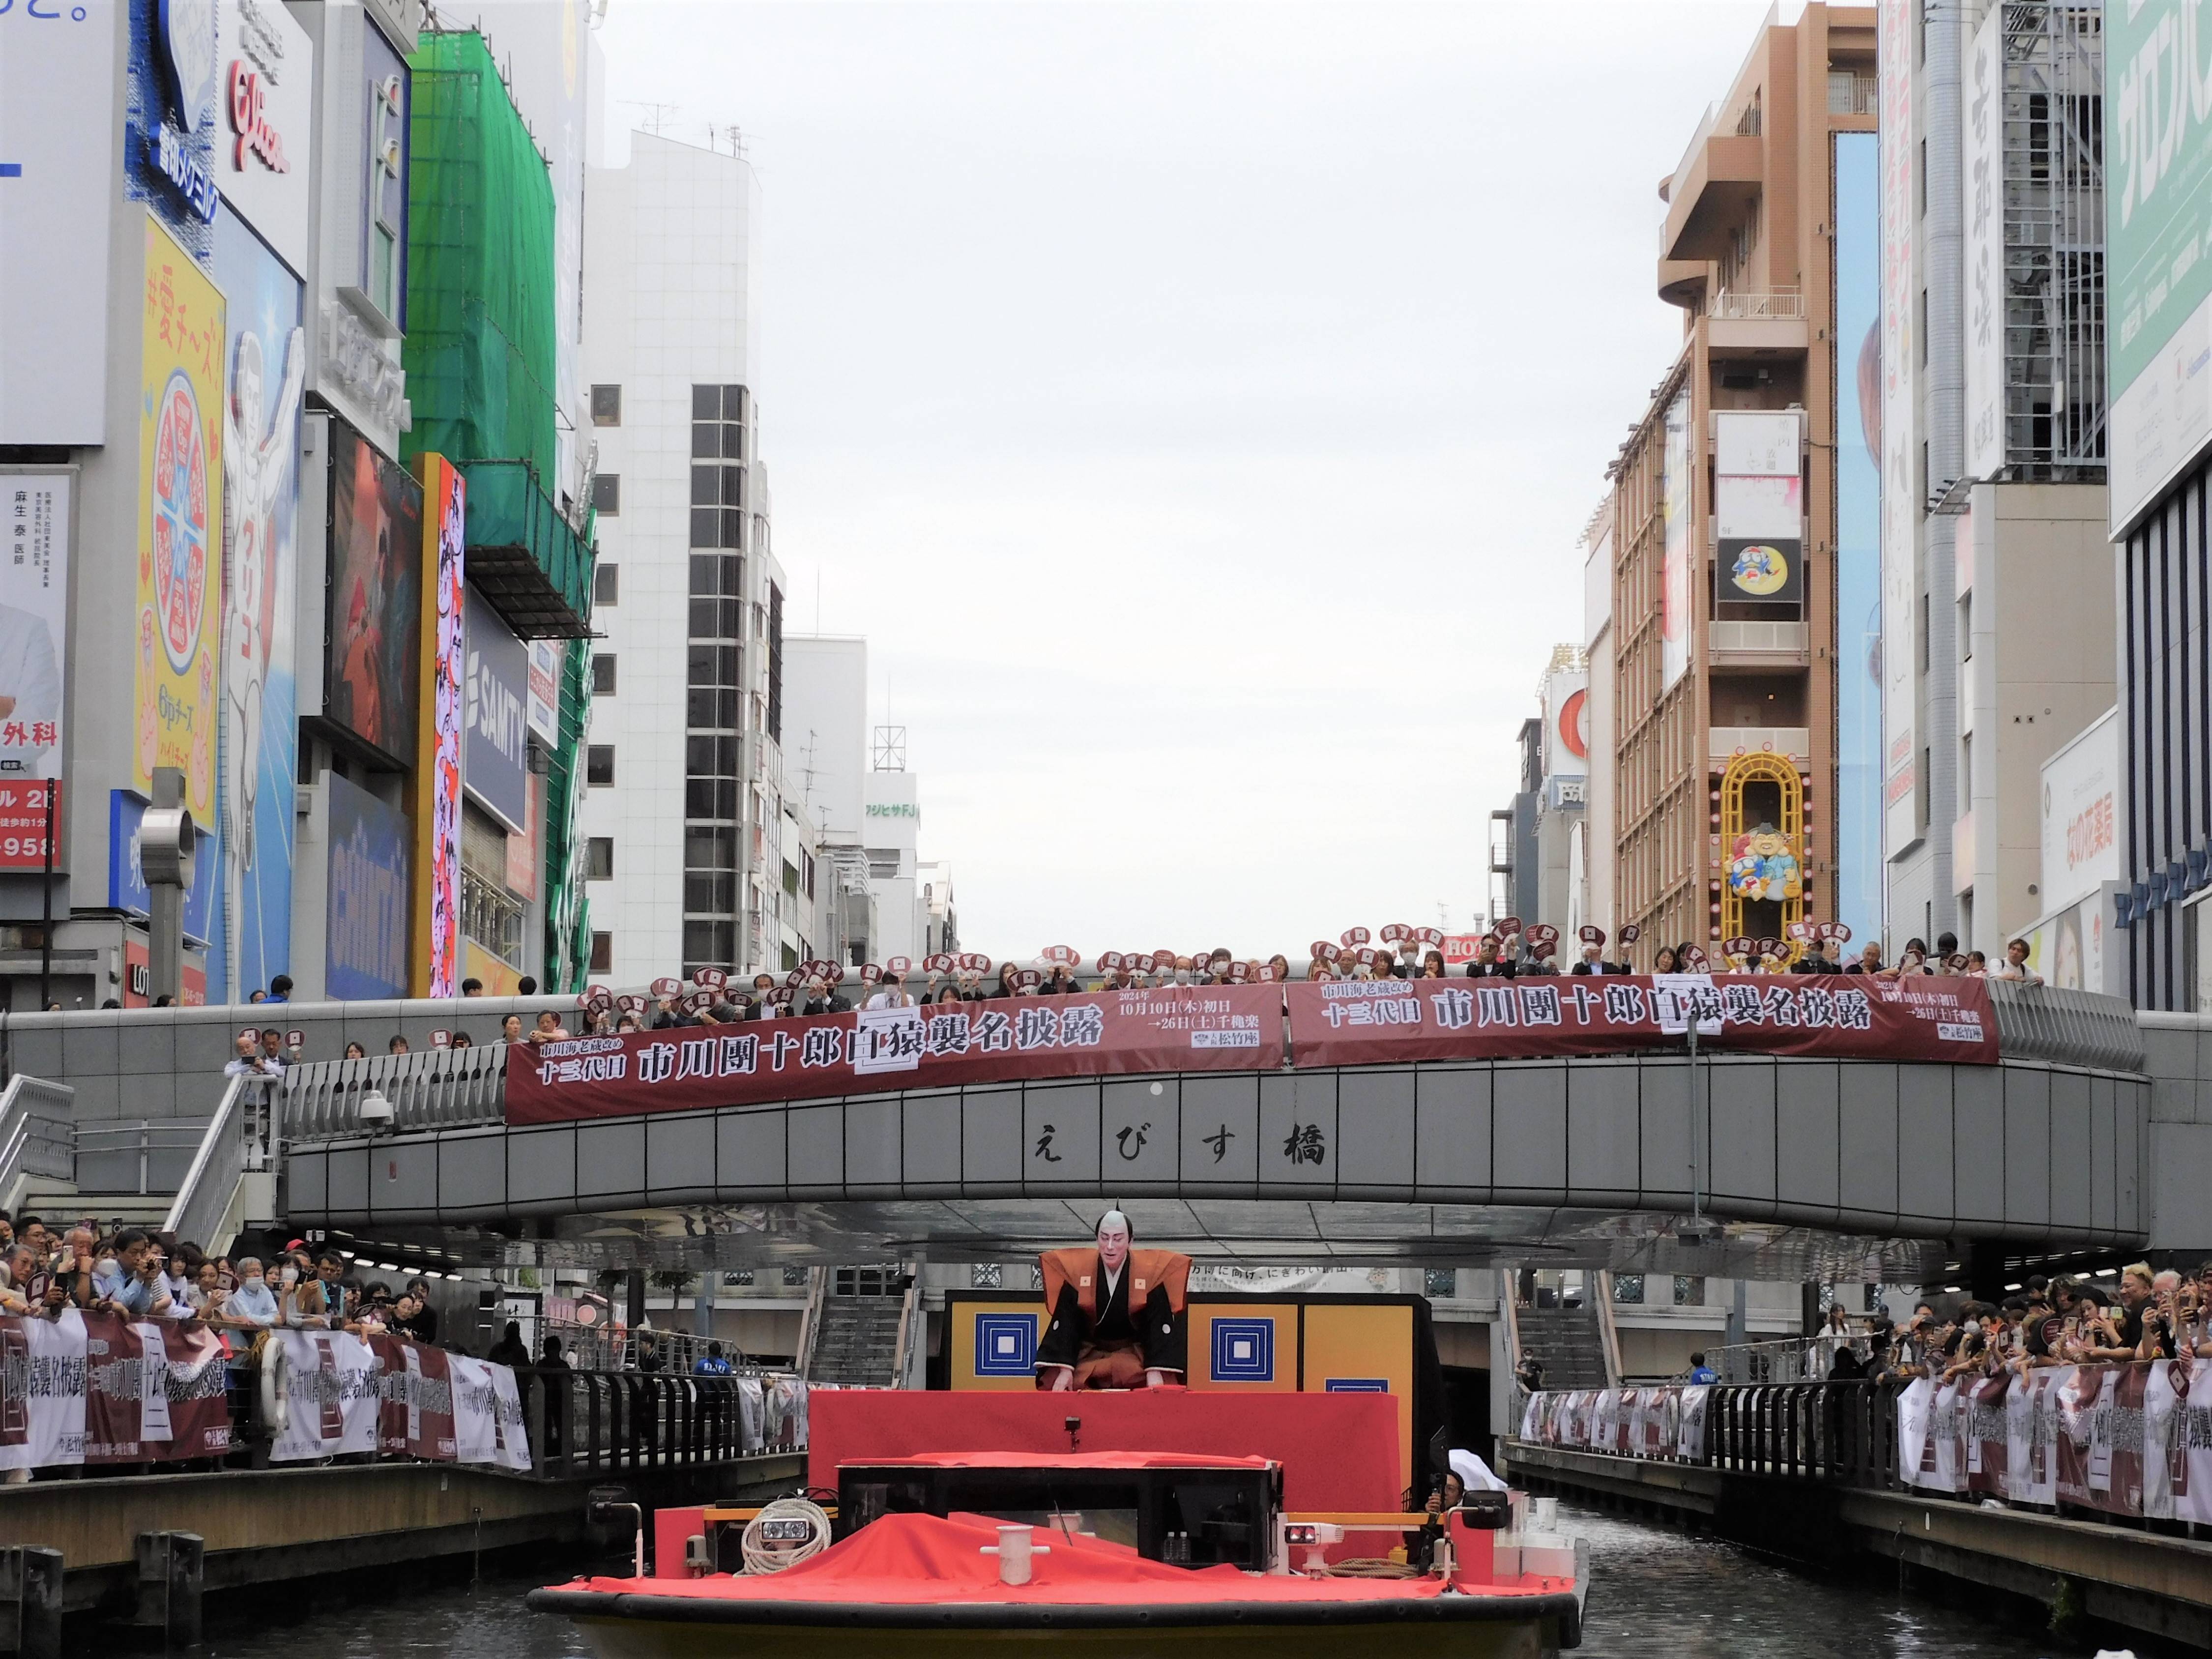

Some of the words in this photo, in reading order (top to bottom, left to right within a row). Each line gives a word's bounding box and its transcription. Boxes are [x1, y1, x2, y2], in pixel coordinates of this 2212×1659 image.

[229, 59, 291, 174] Glico
[2118, 0, 2212, 231] サロンパ
[158, 122, 219, 225] 雪印メグミルク
[14, 491, 28, 517] 麻生
[14, 524, 27, 537] 泰
[14, 543, 25, 565] 医師
[480, 664, 526, 770] SAMTY
[3, 721, 58, 747] 外科
[2066, 791, 2113, 872] なの花薬局
[1119, 990, 1150, 1001] 2024年
[1321, 981, 1414, 999] 市川海老蔵改め
[1119, 1000, 1231, 1016] 10月10日(木)初日
[1321, 997, 1422, 1028] 十三代目
[539, 1038, 624, 1058] 市川海老蔵改め
[536, 1054, 627, 1085] 十三代目
[1034, 1121, 1326, 1165] えびす橋
